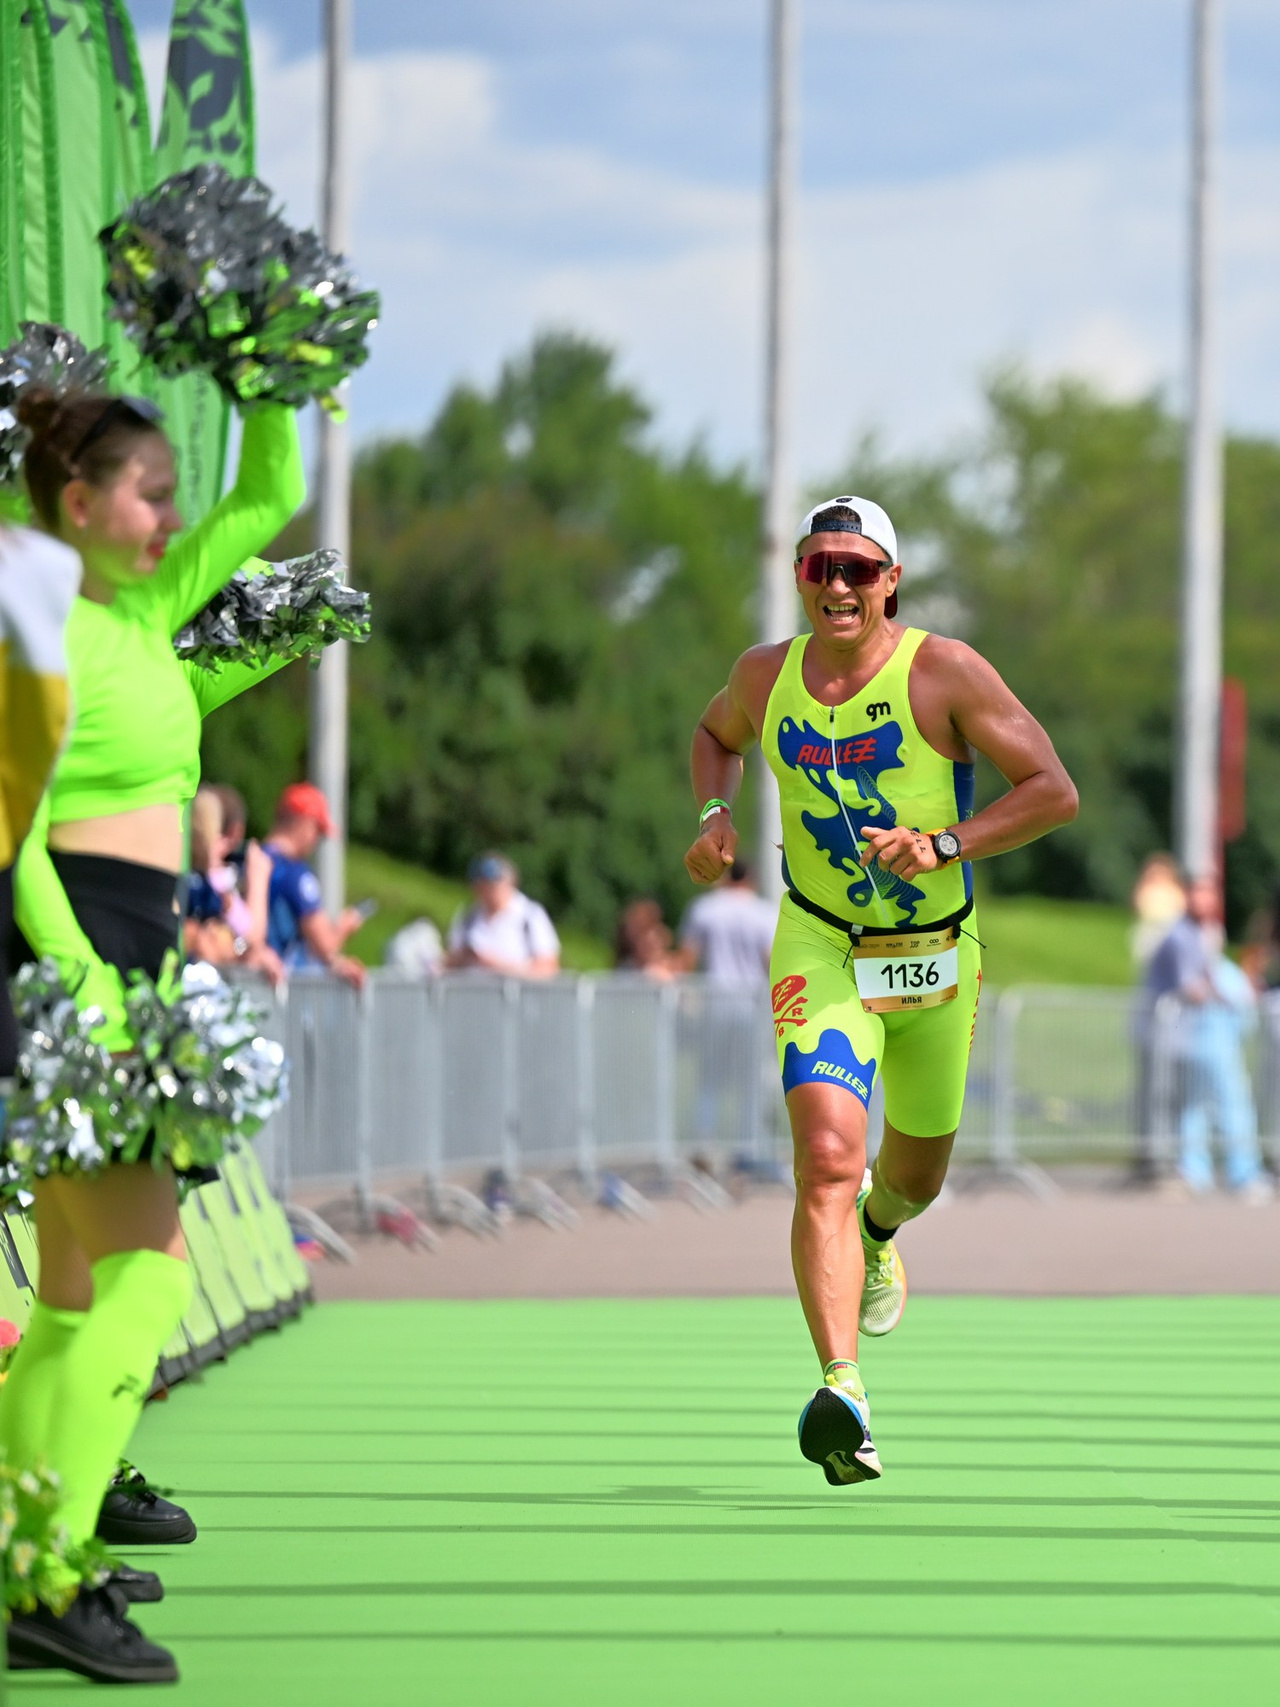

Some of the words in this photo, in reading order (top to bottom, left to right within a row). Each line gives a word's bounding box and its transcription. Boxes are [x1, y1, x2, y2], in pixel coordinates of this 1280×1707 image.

[880, 961, 940, 989] 1136
[901, 996, 922, 1005] ИЛЬЯ
[811, 1060, 868, 1100] RULLEZ
